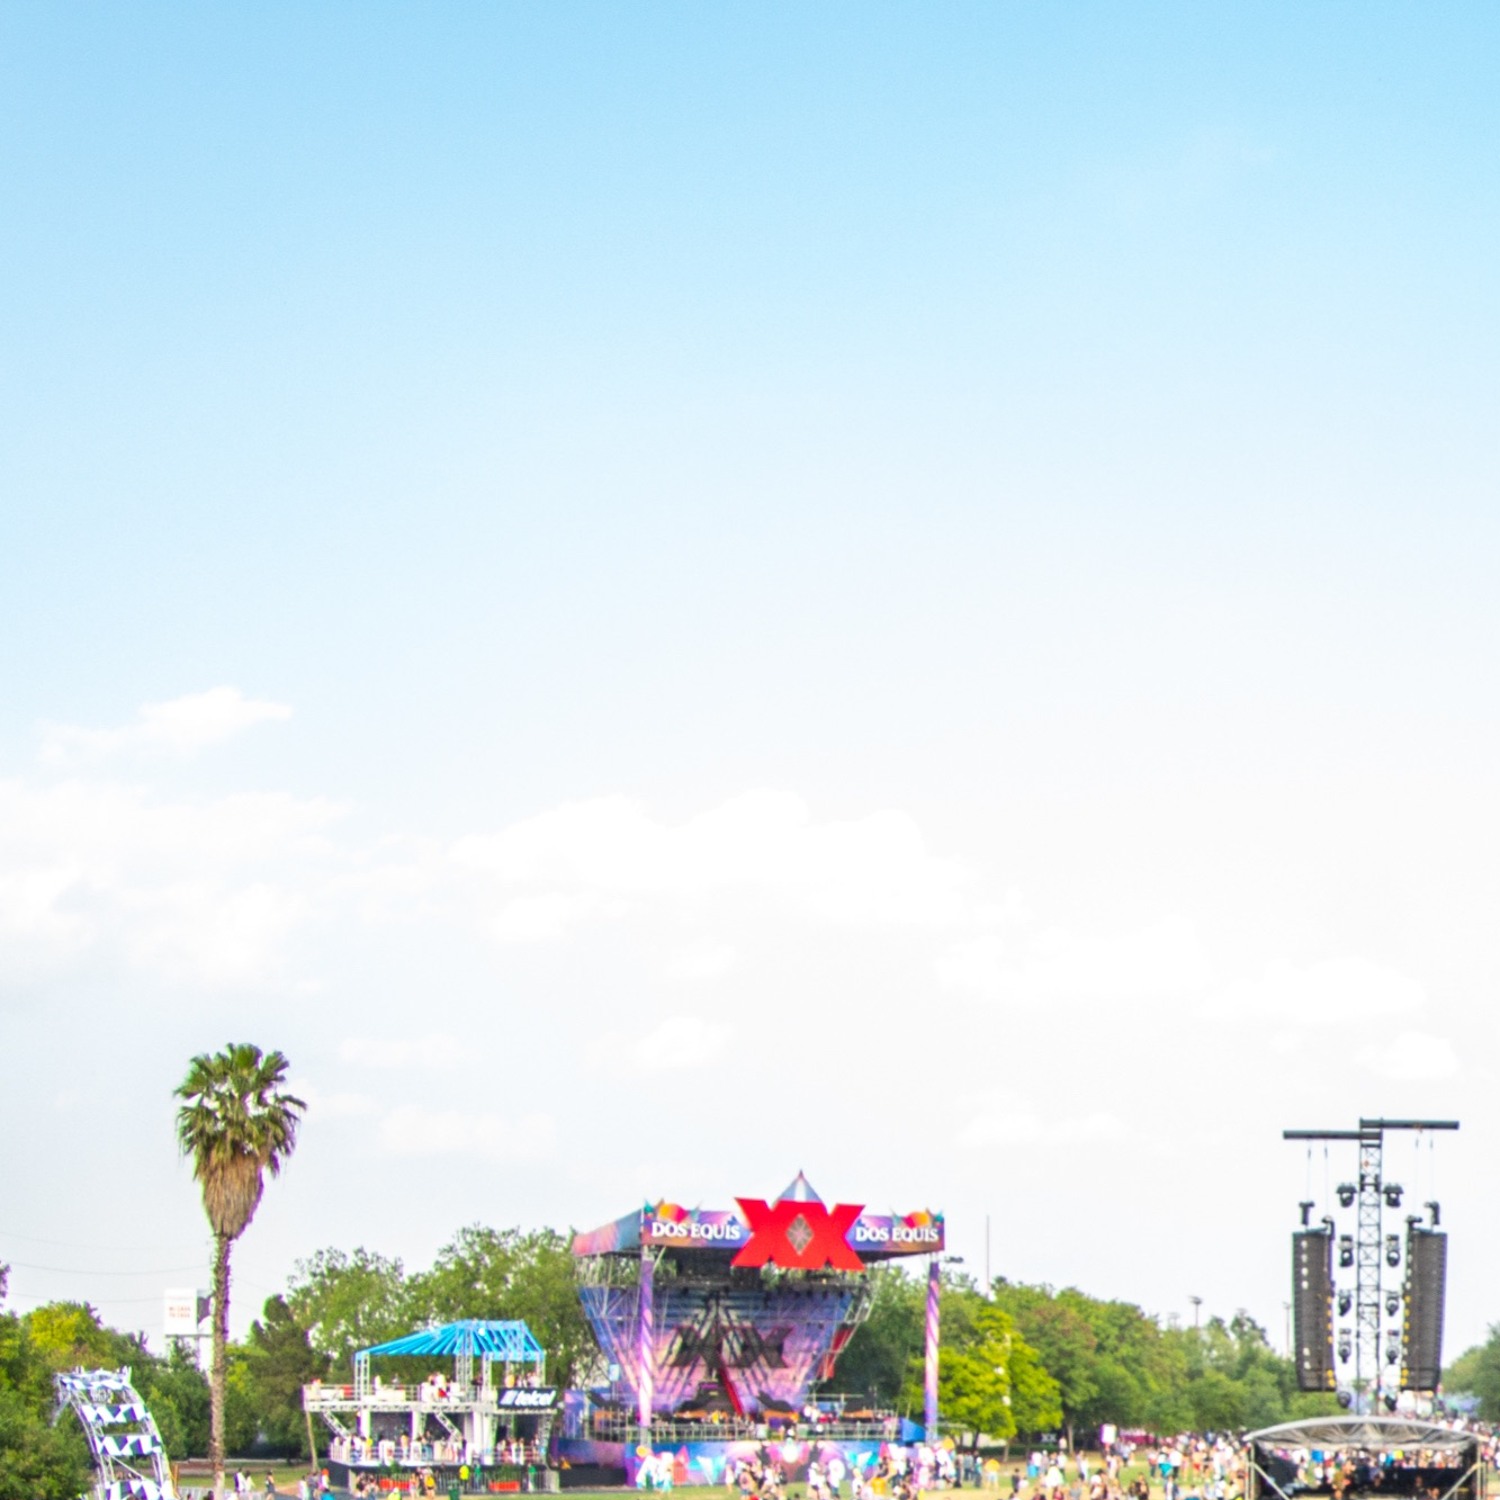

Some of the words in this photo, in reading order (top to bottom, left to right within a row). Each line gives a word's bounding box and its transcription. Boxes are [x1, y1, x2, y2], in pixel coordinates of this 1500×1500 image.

[651, 1221, 689, 1239] DOS
[690, 1223, 741, 1241] EQUIS
[855, 1226, 889, 1242] DOS
[891, 1227, 939, 1243] EQUIS
[514, 1389, 557, 1407] telcel
